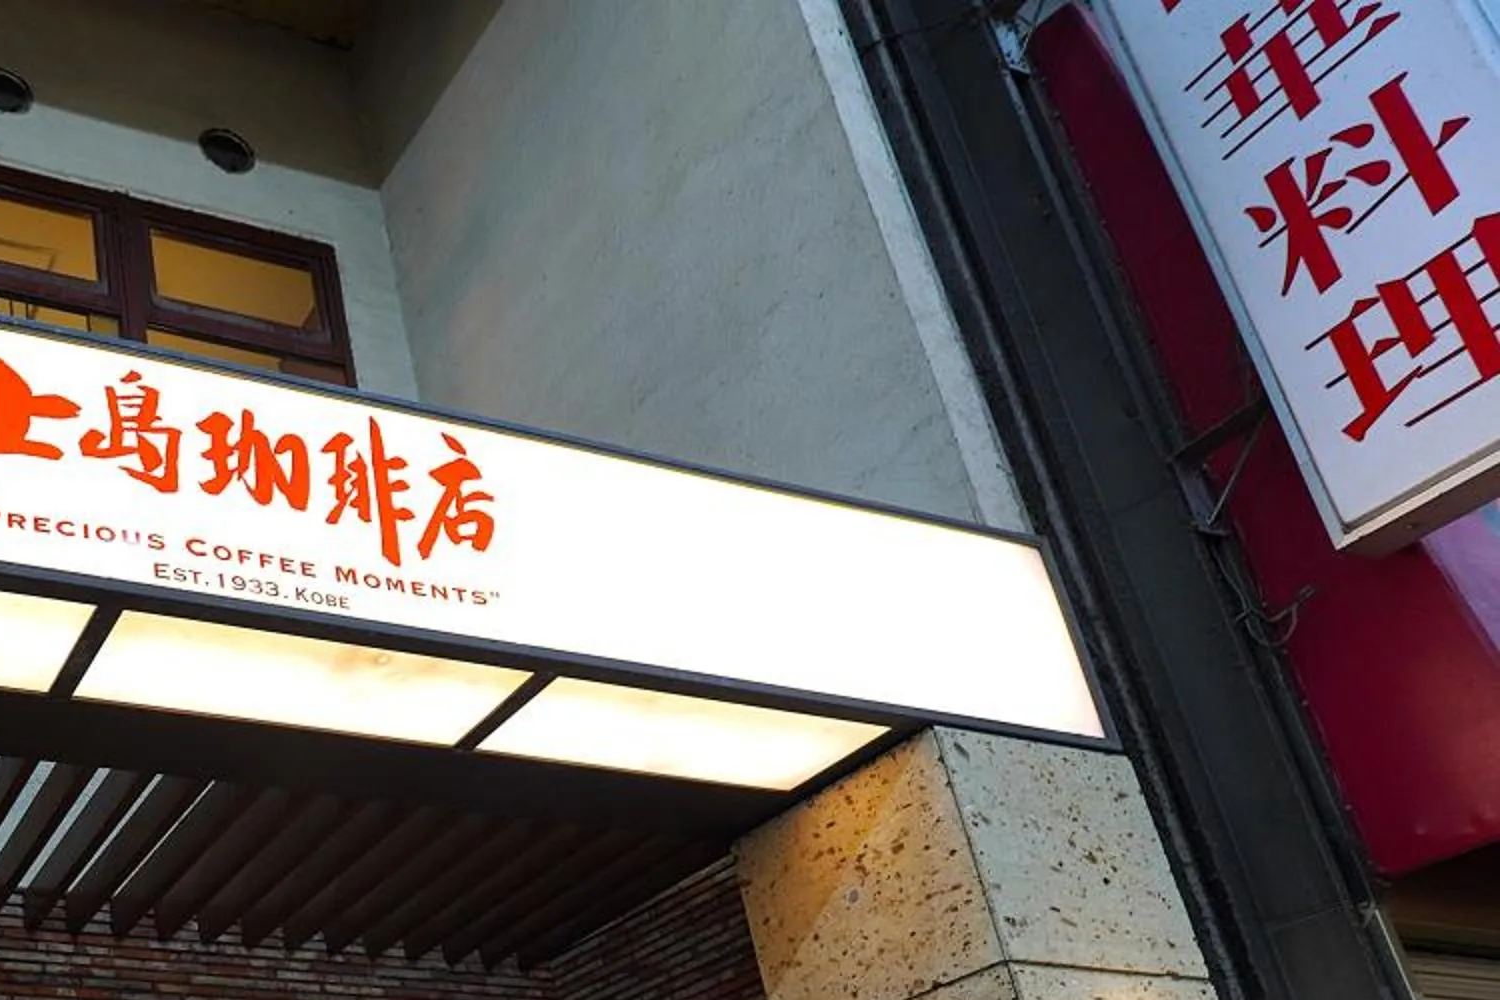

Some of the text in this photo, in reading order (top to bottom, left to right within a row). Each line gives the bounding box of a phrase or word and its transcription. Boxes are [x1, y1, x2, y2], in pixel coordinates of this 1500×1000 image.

[1160, 0, 1500, 442] 華料理
[185, 538, 317, 579] COFFEE
[335, 565, 500, 606] MOMENTS"
